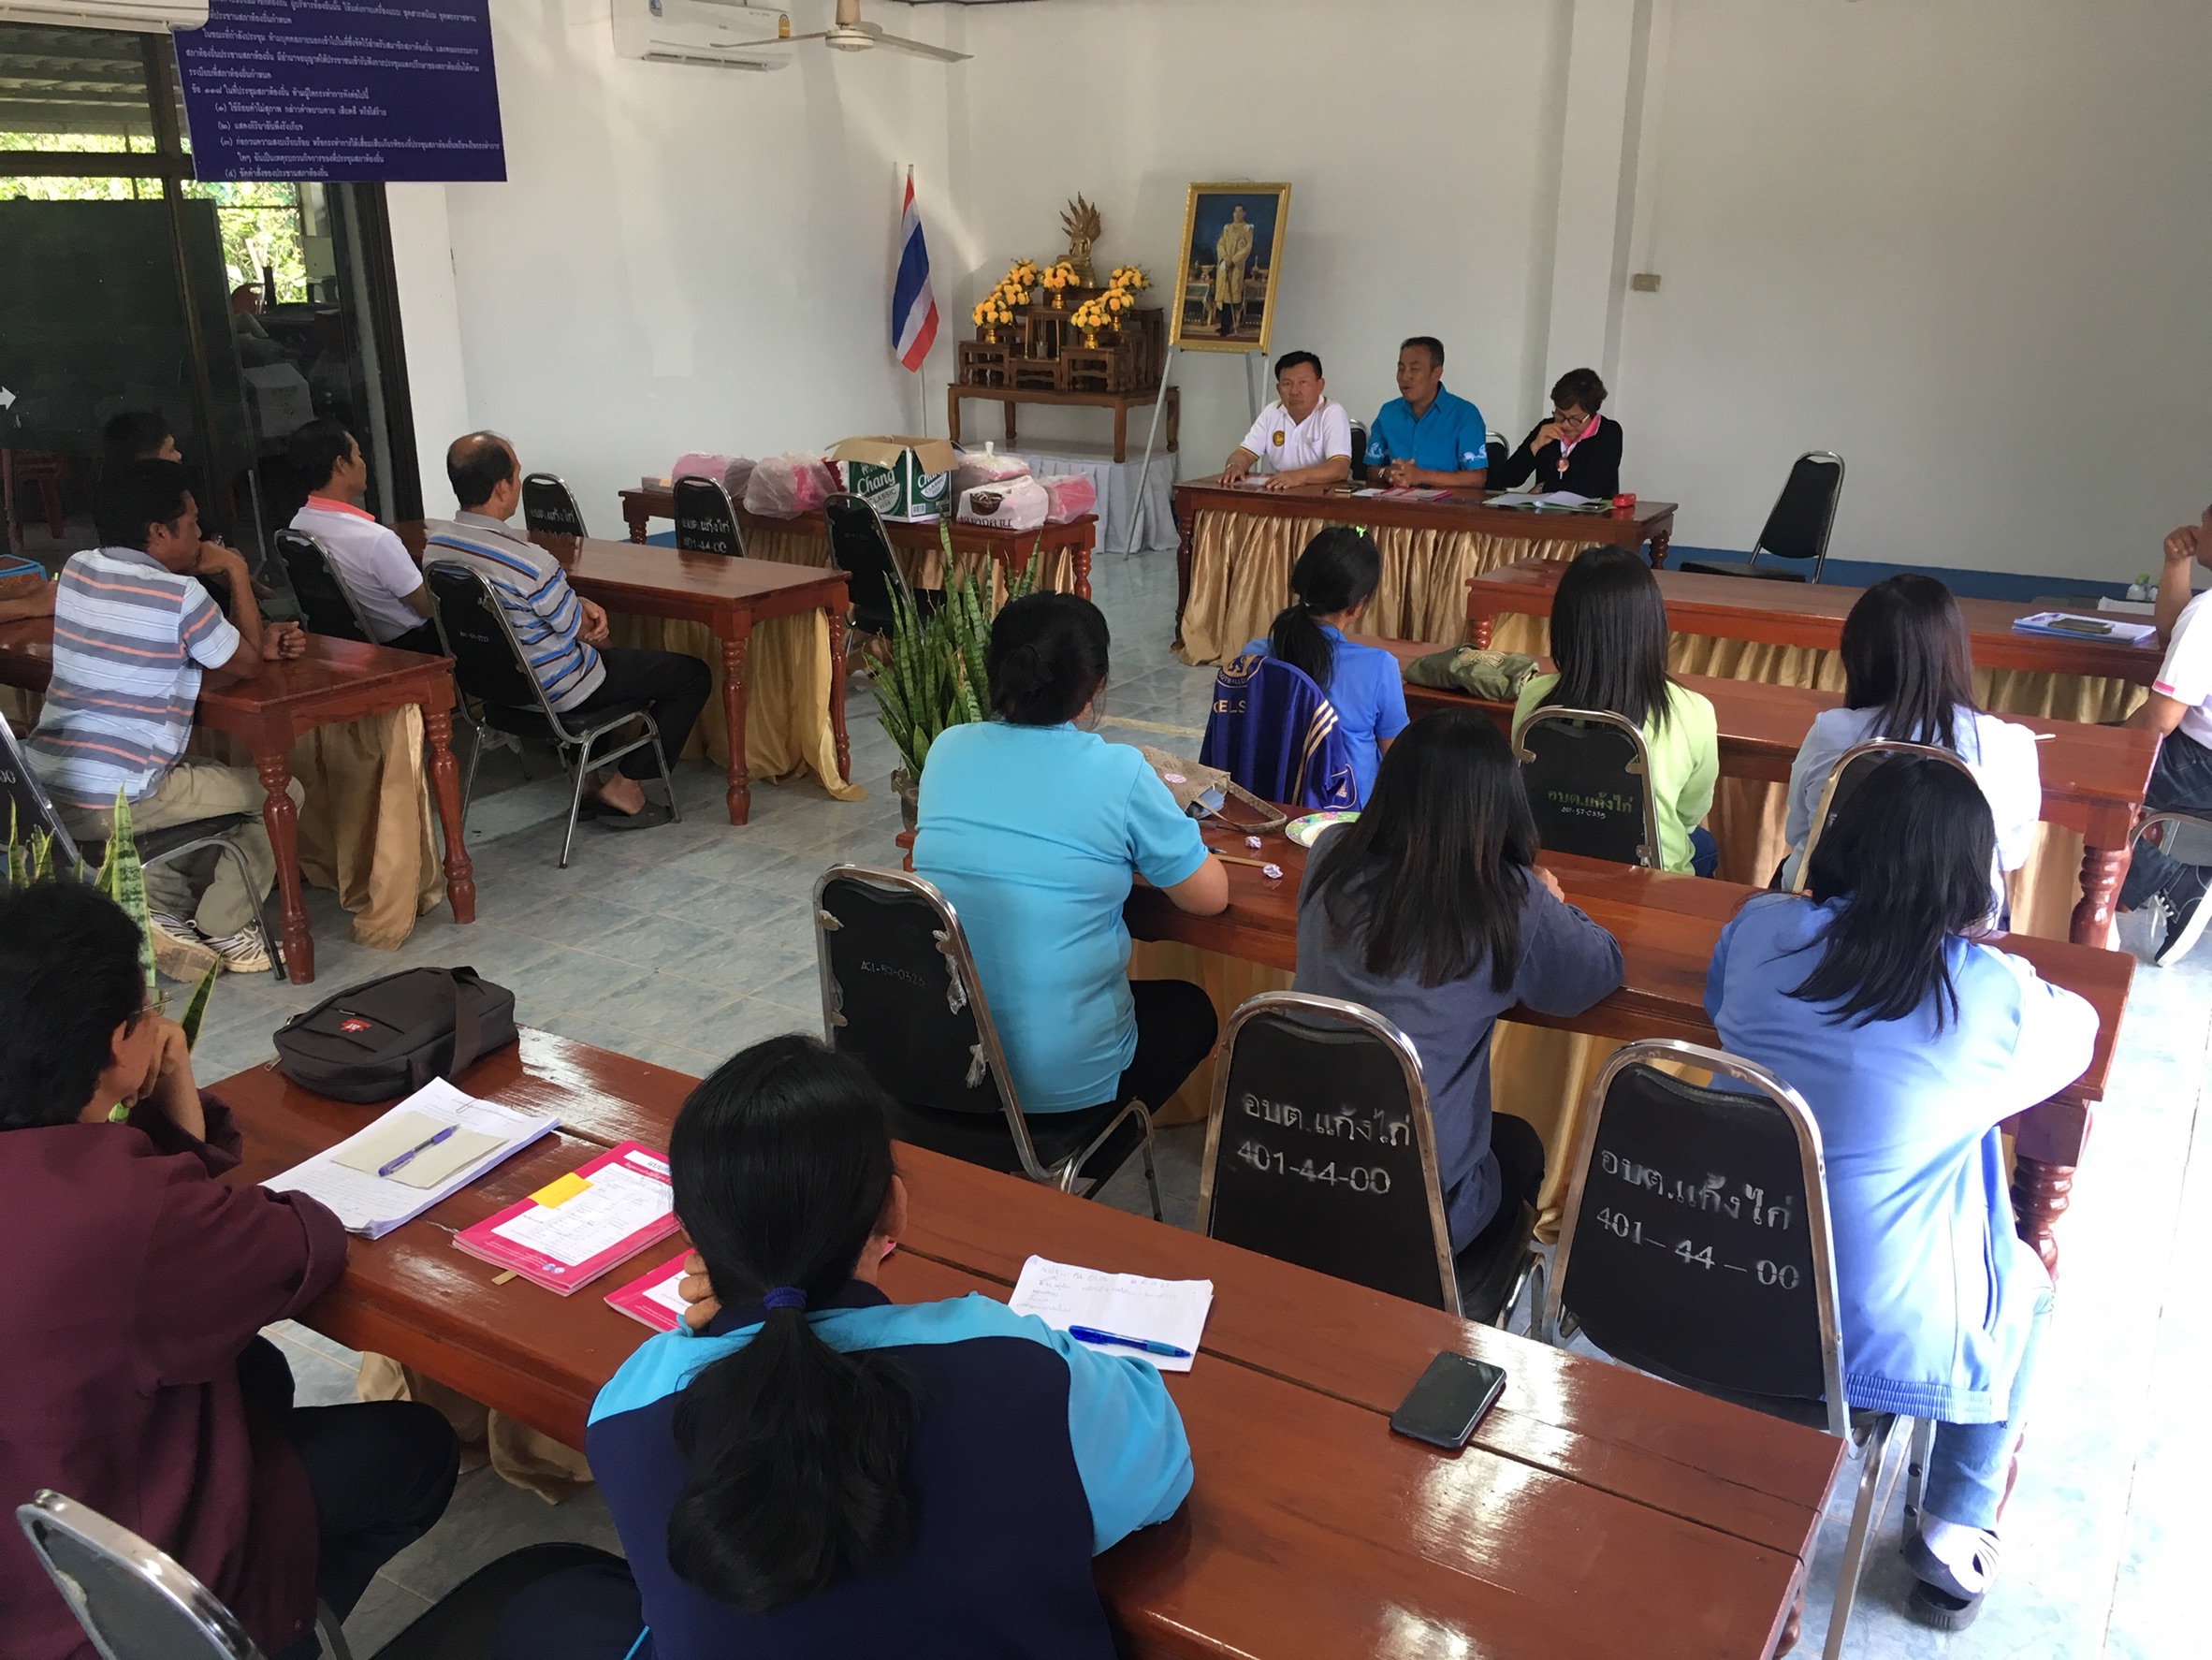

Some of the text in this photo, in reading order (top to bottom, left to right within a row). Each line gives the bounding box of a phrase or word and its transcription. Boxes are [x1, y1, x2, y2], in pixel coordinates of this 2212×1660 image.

[191, 82, 201, 95] ข้อ
[224, 81, 290, 97] ในที่ประชุมสภาท้องถิ่น
[214, 103, 227, 113] (๑)
[227, 101, 283, 116] ใช้ถ้อยคำไม่สุภาพ
[217, 120, 231, 131] (๒)
[220, 137, 233, 147] (๓)
[225, 167, 237, 178] (๔)
[857, 469, 895, 496] Chang
[1242, 1092, 1411, 1146] อบต.แก้งไก่
[1236, 1140, 1391, 1195] 401-44-00
[1600, 1149, 1794, 1230] อบต.แก้งไก่
